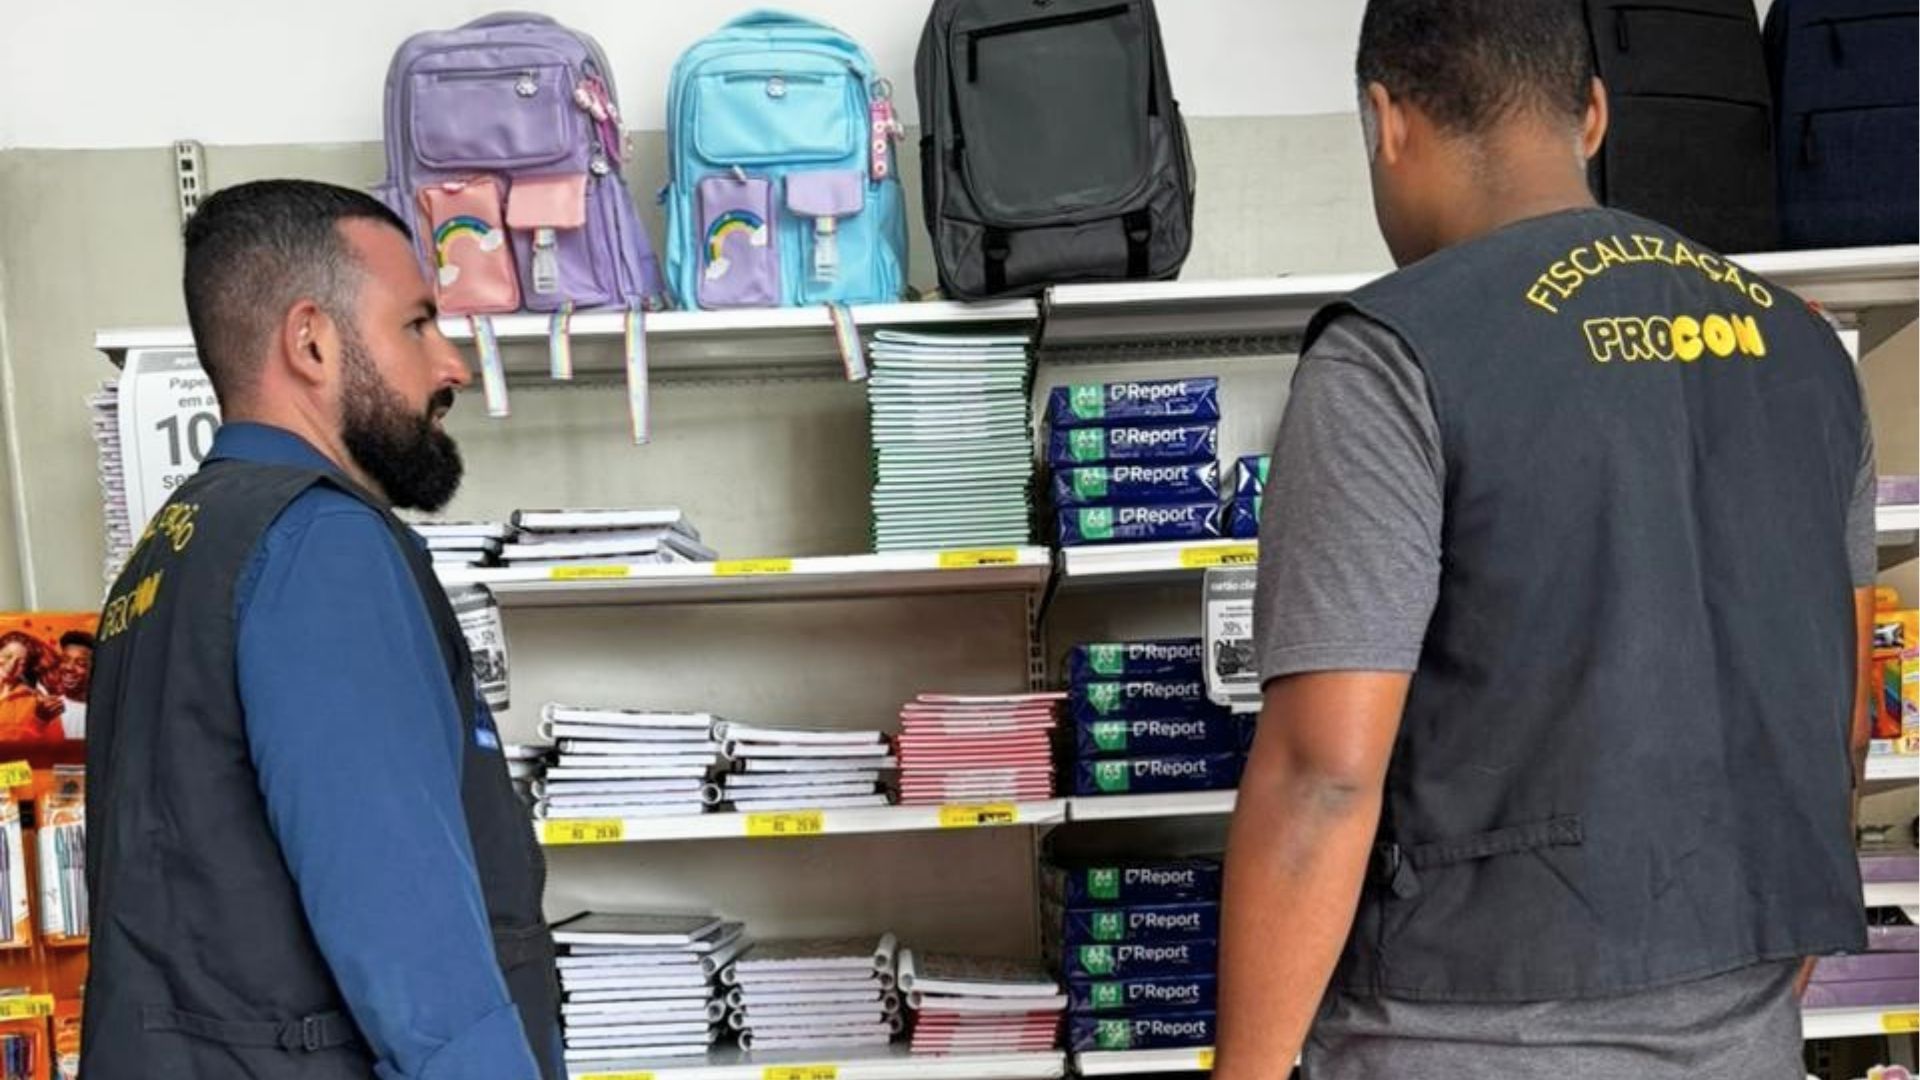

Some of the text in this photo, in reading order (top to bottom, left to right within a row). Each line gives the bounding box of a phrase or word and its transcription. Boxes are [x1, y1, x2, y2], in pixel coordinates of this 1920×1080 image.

[1526, 235, 1773, 314] FISCALIZAÇÃO
[1584, 314, 1766, 362] PROCON
[1127, 382, 1187, 401] Report
[1127, 427, 1187, 446] Report
[1131, 465, 1189, 485] Report
[1137, 506, 1195, 526] Report
[1145, 643, 1201, 661] Report
[1143, 682, 1200, 700] Report
[1149, 720, 1206, 738] Report
[1150, 760, 1208, 777] Report
[1140, 868, 1195, 886] Report
[1145, 912, 1201, 930] Report
[1133, 945, 1189, 962] Report
[1145, 983, 1200, 1001] Report
[1152, 1020, 1206, 1037] Report
